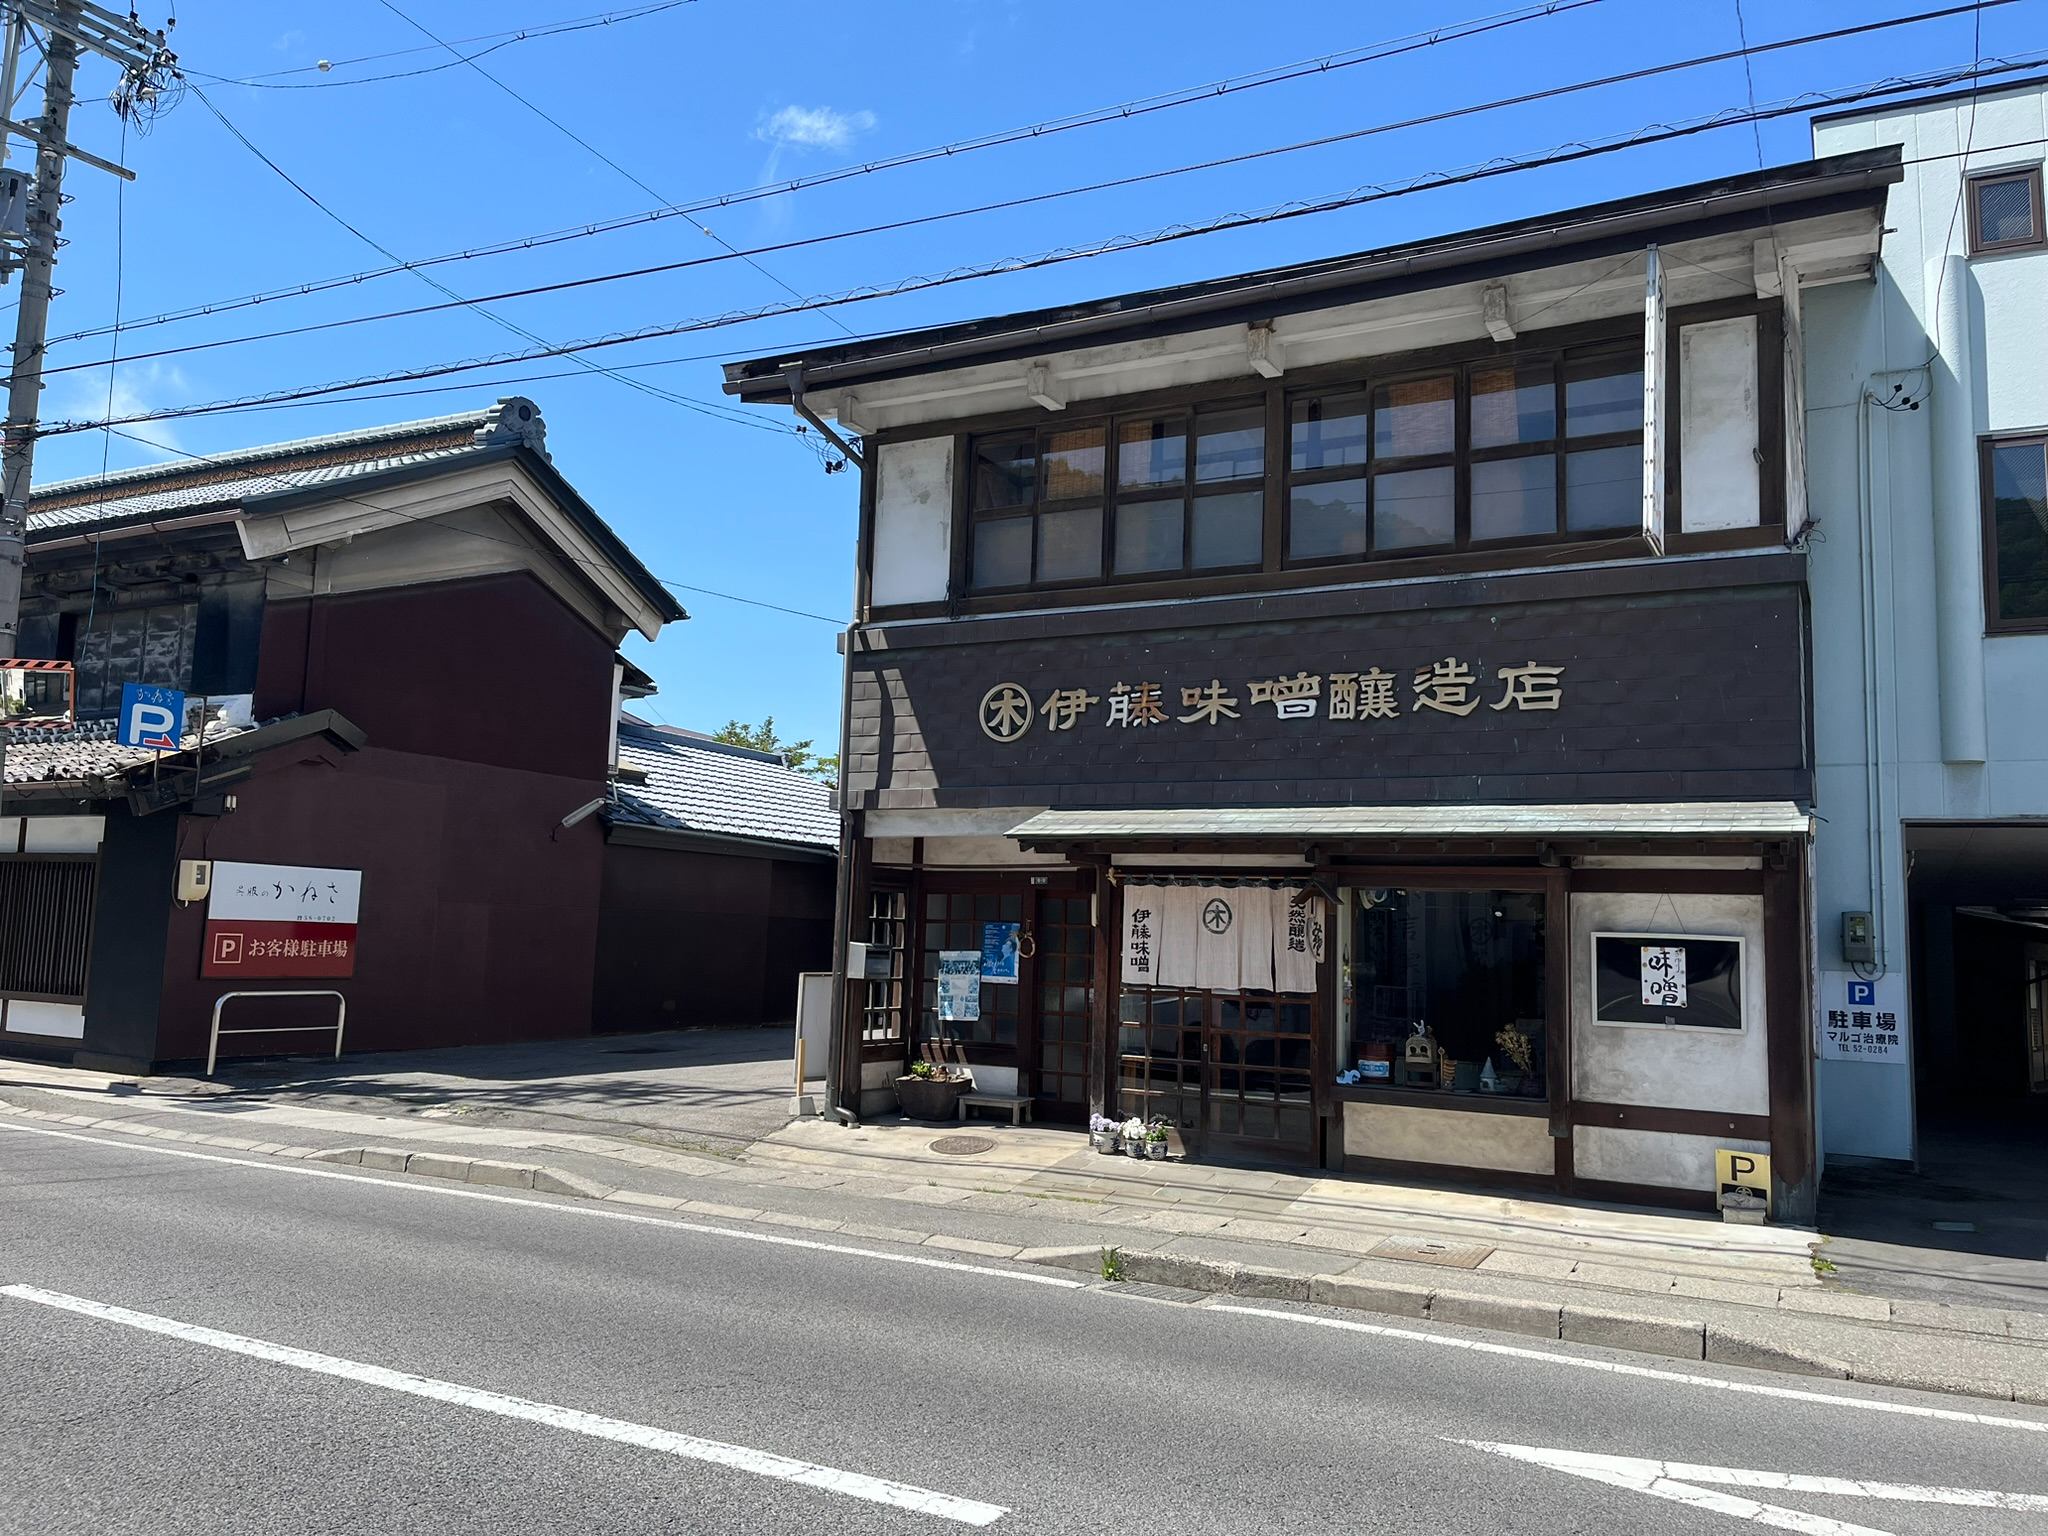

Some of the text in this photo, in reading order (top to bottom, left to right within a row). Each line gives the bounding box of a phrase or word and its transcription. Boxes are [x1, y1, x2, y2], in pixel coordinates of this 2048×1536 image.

[129, 703, 174, 745] P
[221, 938, 349, 958] P お客様駐車場
[1130, 908, 1152, 973] 伊藤味噌
[1854, 984, 1869, 1001] P
[1828, 1010, 1896, 1031] 駐車場
[1826, 1031, 1899, 1046] マルゴ治療院
[1838, 1044, 1850, 1052] TEL
[1730, 1155, 1755, 1181] P
